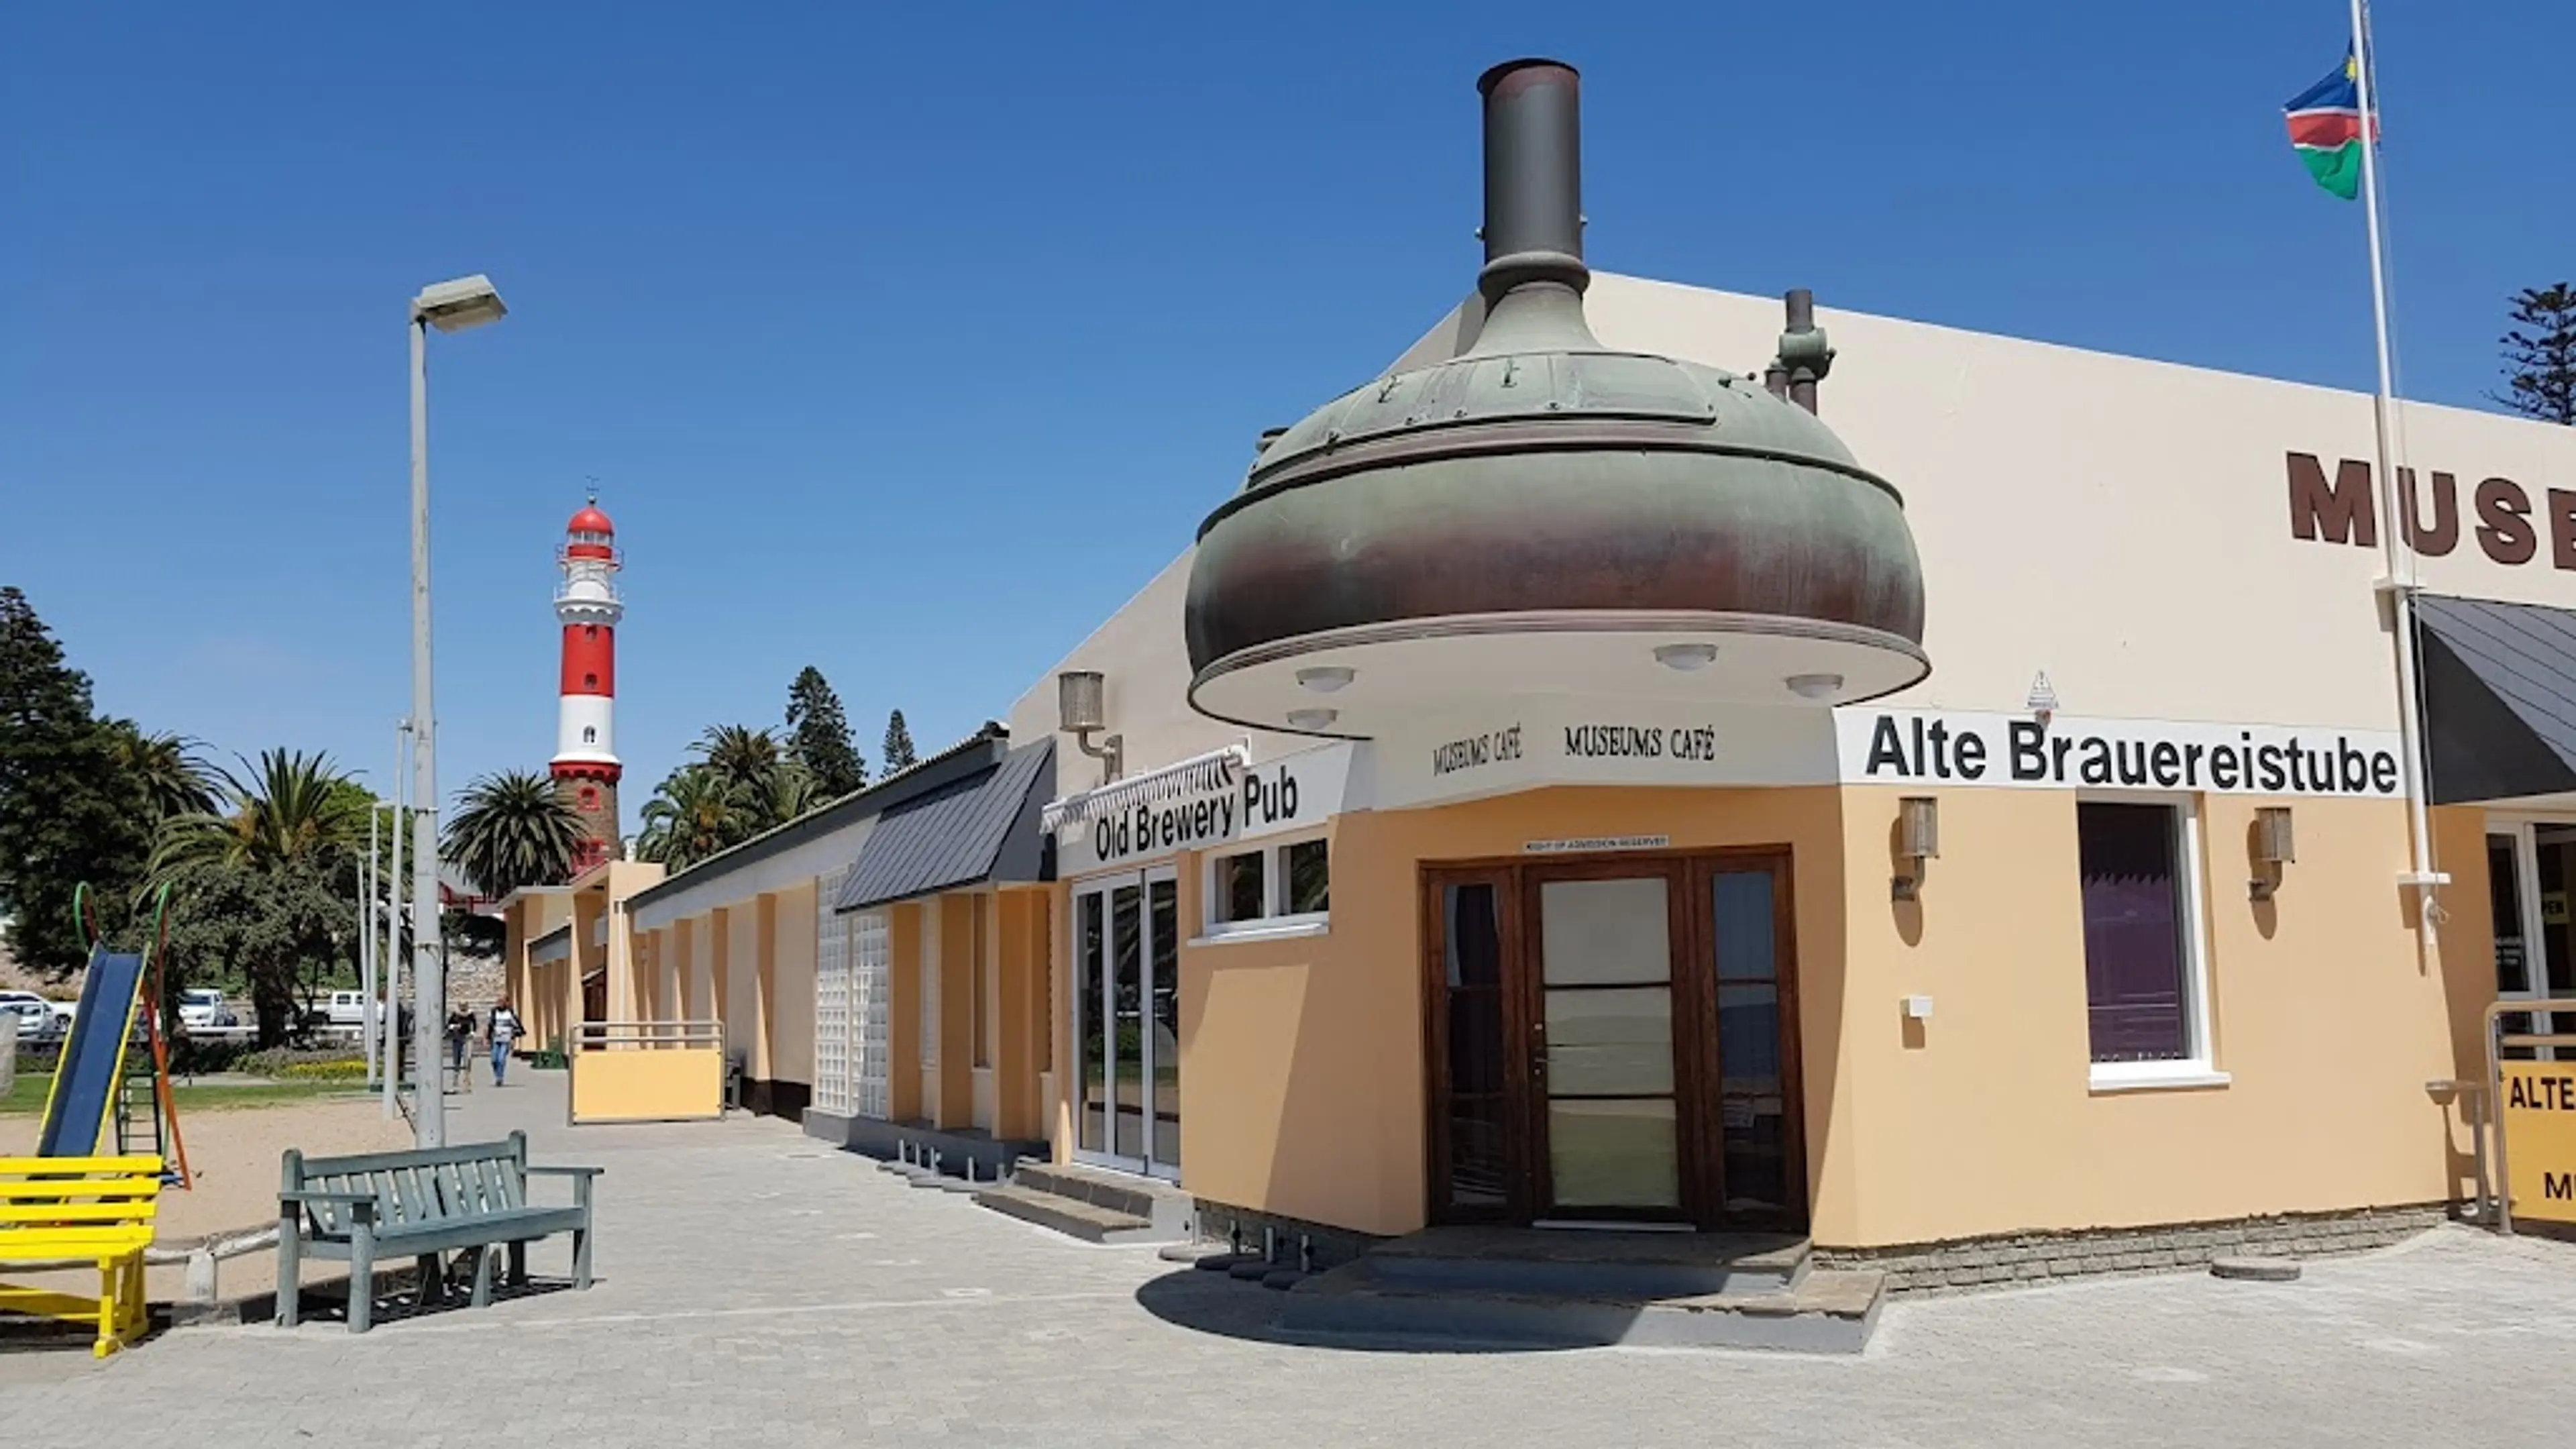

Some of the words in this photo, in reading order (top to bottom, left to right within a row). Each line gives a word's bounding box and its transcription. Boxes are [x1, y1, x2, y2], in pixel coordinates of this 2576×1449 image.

[1434, 734, 1489, 777] MUSEUMS
[1495, 721, 1523, 761] CAFÉ
[1564, 724, 1662, 757] MUSEUMS
[1670, 724, 1715, 761] CAFÉ
[1866, 714, 1986, 781] Alte
[2009, 720, 2398, 794] Brauereistube
[1096, 808, 1129, 861] Old
[1136, 792, 1235, 852] Brewery
[1244, 765, 1297, 828] Pub
[2510, 1076, 2575, 1110] ALTE
[2543, 1171, 2576, 1201] M
